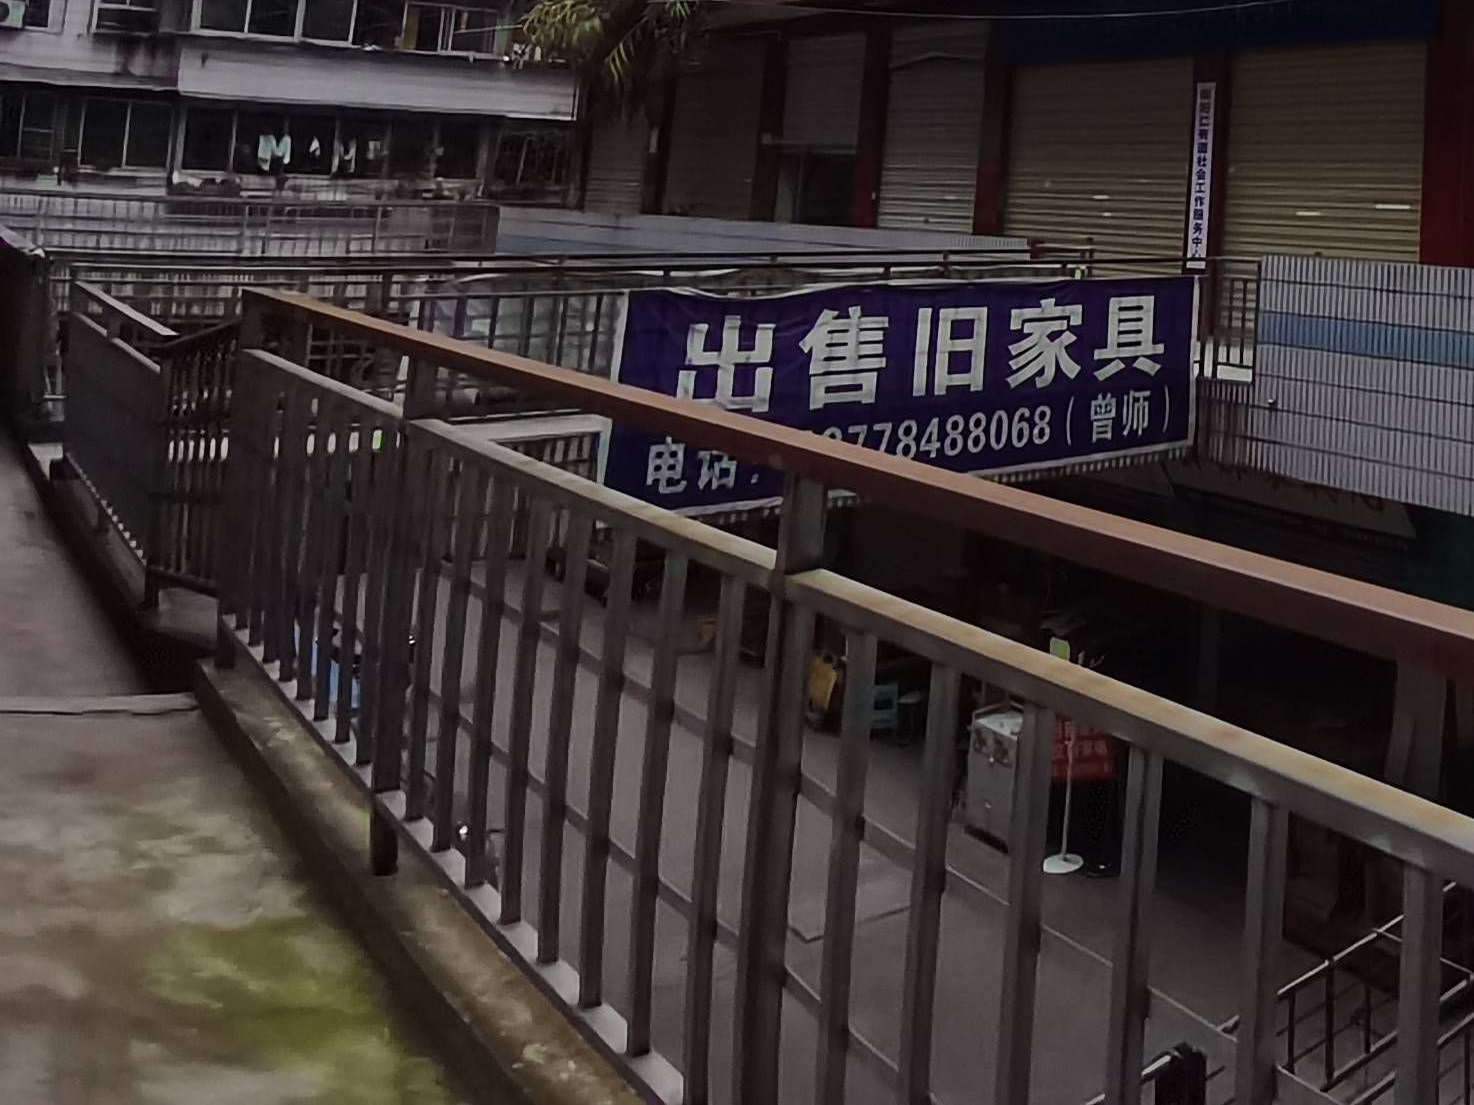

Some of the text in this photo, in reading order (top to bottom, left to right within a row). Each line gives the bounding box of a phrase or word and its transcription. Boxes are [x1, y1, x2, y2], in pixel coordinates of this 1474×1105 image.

[676, 296, 1165, 412] 出售旧家具
[812, 405, 1050, 461] 778488068
